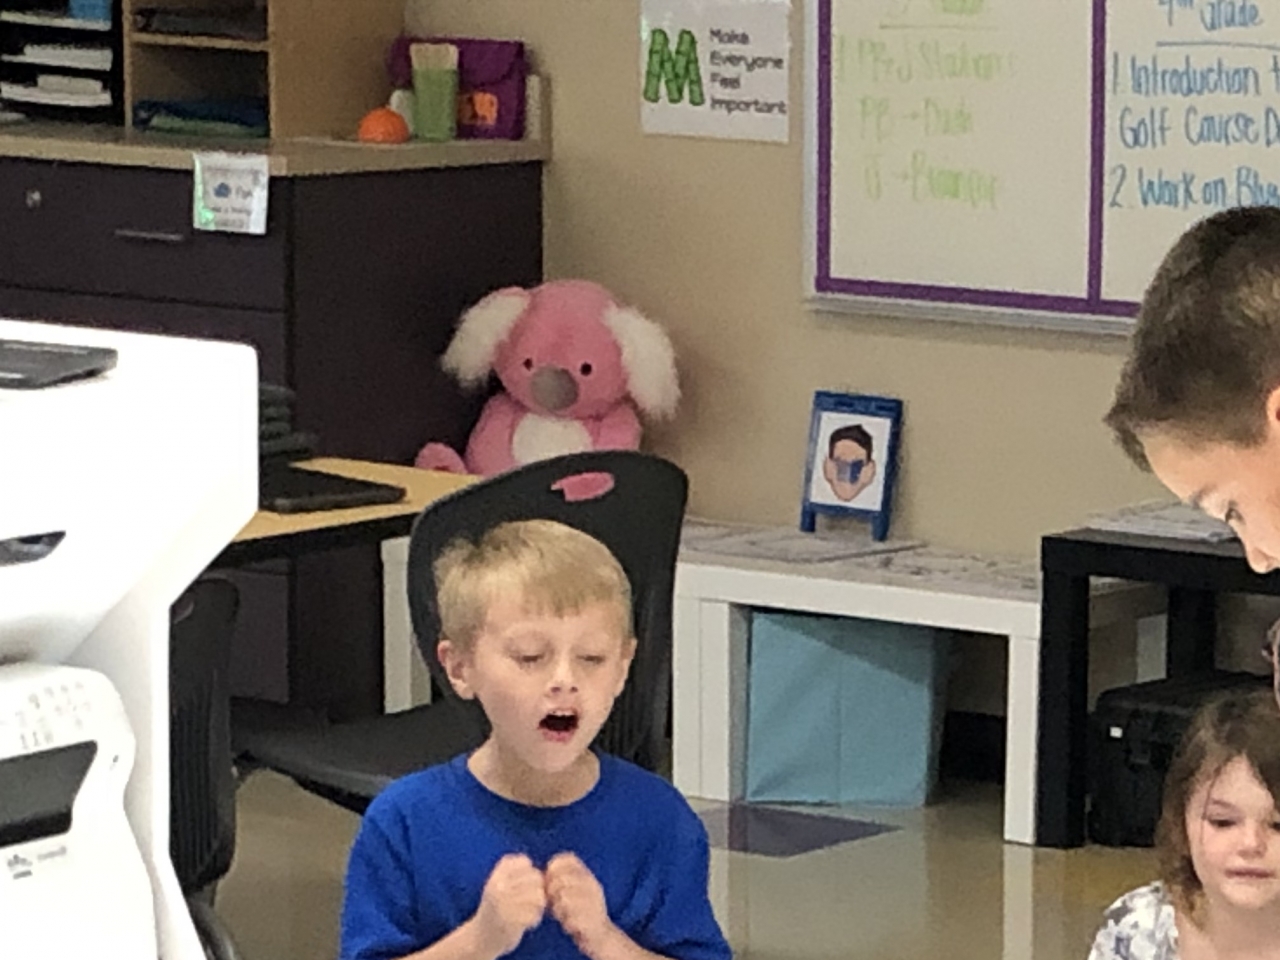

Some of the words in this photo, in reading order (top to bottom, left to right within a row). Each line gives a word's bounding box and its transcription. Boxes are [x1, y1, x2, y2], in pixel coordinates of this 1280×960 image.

[1201, 0, 1263, 31] Grade
[709, 29, 749, 45] Make
[710, 50, 784, 72] Everyone
[711, 74, 741, 89] Feel
[1130, 54, 1260, 97] Introduction
[710, 97, 787, 115] Important
[1119, 105, 1172, 149] Golf
[1184, 105, 1260, 146] Course
[1137, 166, 1198, 209] Work
[1203, 178, 1226, 206] on
